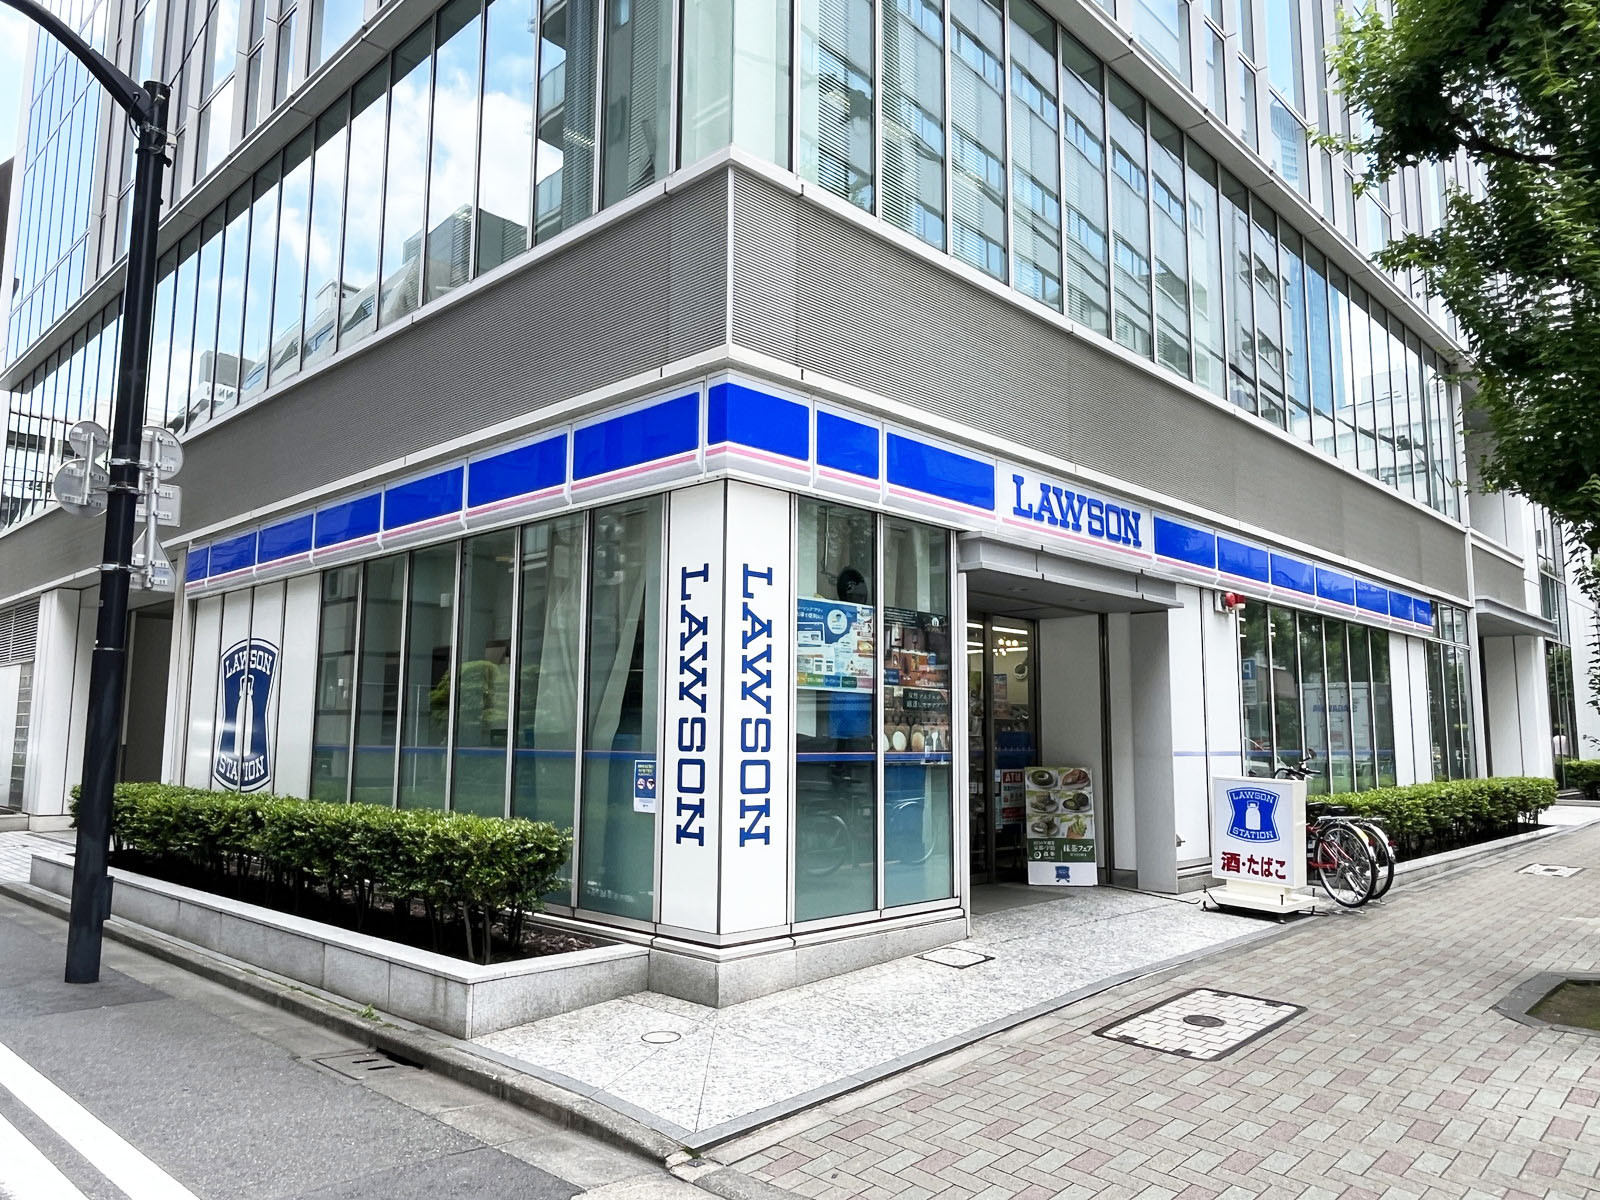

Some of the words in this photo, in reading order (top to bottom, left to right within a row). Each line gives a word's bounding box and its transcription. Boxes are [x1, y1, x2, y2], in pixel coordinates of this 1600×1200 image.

[1012, 473, 1142, 548] LAWSON
[675, 563, 709, 847] LAWSON
[739, 563, 773, 847] LAWSON
[218, 754, 265, 781] STAION
[1232, 792, 1274, 804] LAWSON
[1232, 826, 1274, 839] STATION
[1221, 851, 1286, 880] 酒・たばこ
